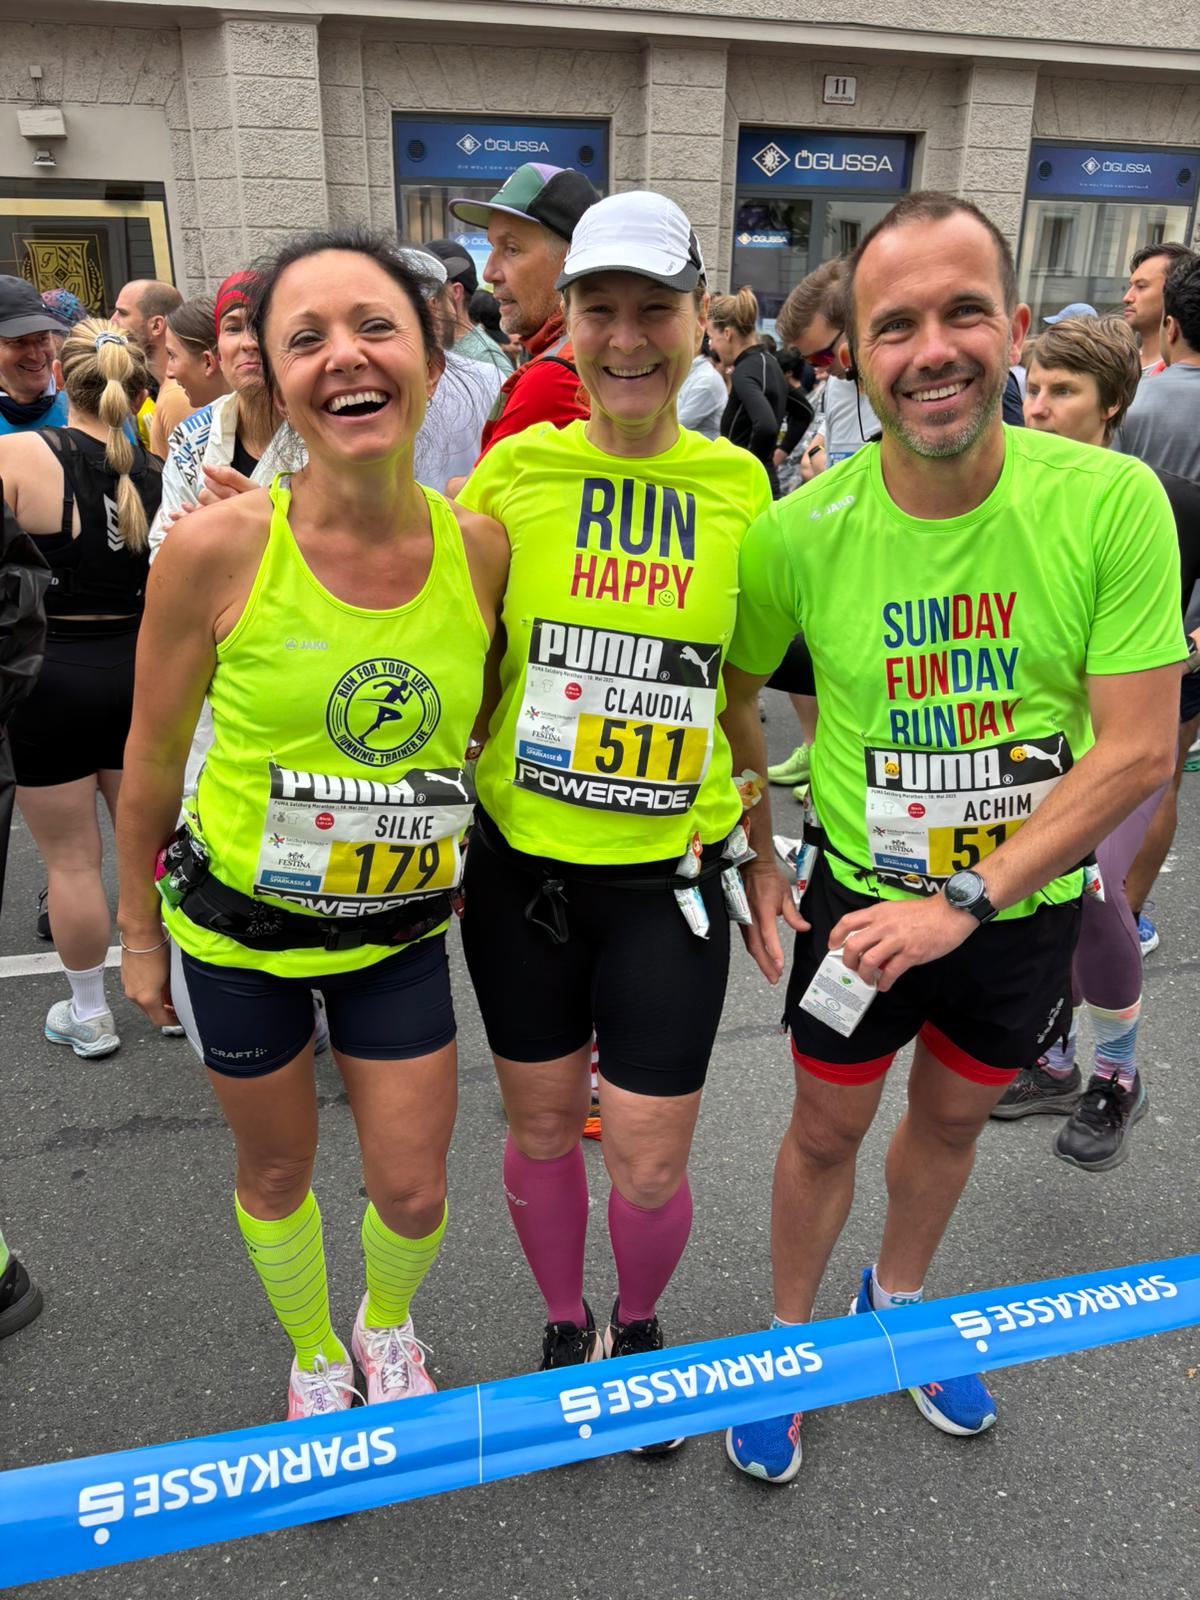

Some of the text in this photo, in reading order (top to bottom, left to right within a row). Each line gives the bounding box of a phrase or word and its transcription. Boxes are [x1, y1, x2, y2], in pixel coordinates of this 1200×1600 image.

[834, 78, 847, 94] 11
[484, 138, 550, 153] ÖGUSSA
[795, 149, 893, 172] ÖGUSSA
[1102, 161, 1152, 174] ÖGUSSA
[576, 477, 696, 561] RUN
[570, 553, 694, 609] HAPPY
[883, 592, 1017, 649] SUNDAY
[538, 622, 664, 680] PUMA
[337, 661, 430, 699] RUN FOR YOUR LIFE
[886, 647, 1019, 700] FUNDAY
[605, 686, 693, 722] CLAUDIA
[889, 697, 1023, 748] RUNDAY
[526, 749, 557, 761] SPARKASSE
[532, 730, 561, 742] FESTINA
[595, 718, 685, 780] 511
[519, 763, 690, 809] POWERADE
[874, 748, 1001, 790] PUMA
[963, 793, 1031, 822] ACHIM
[375, 815, 434, 840] SILKE
[278, 858, 311, 869] FESTINA
[355, 842, 440, 894] 179
[884, 845, 914, 853] FESTINA
[270, 877, 305, 886] SPARKASSE
[210, 1047, 253, 1059] CRAFT
[985, 1274, 1178, 1332] SPARKASSE
[602, 1342, 823, 1415] SPARKASSE
[133, 1426, 397, 1518] SPARKASSE
